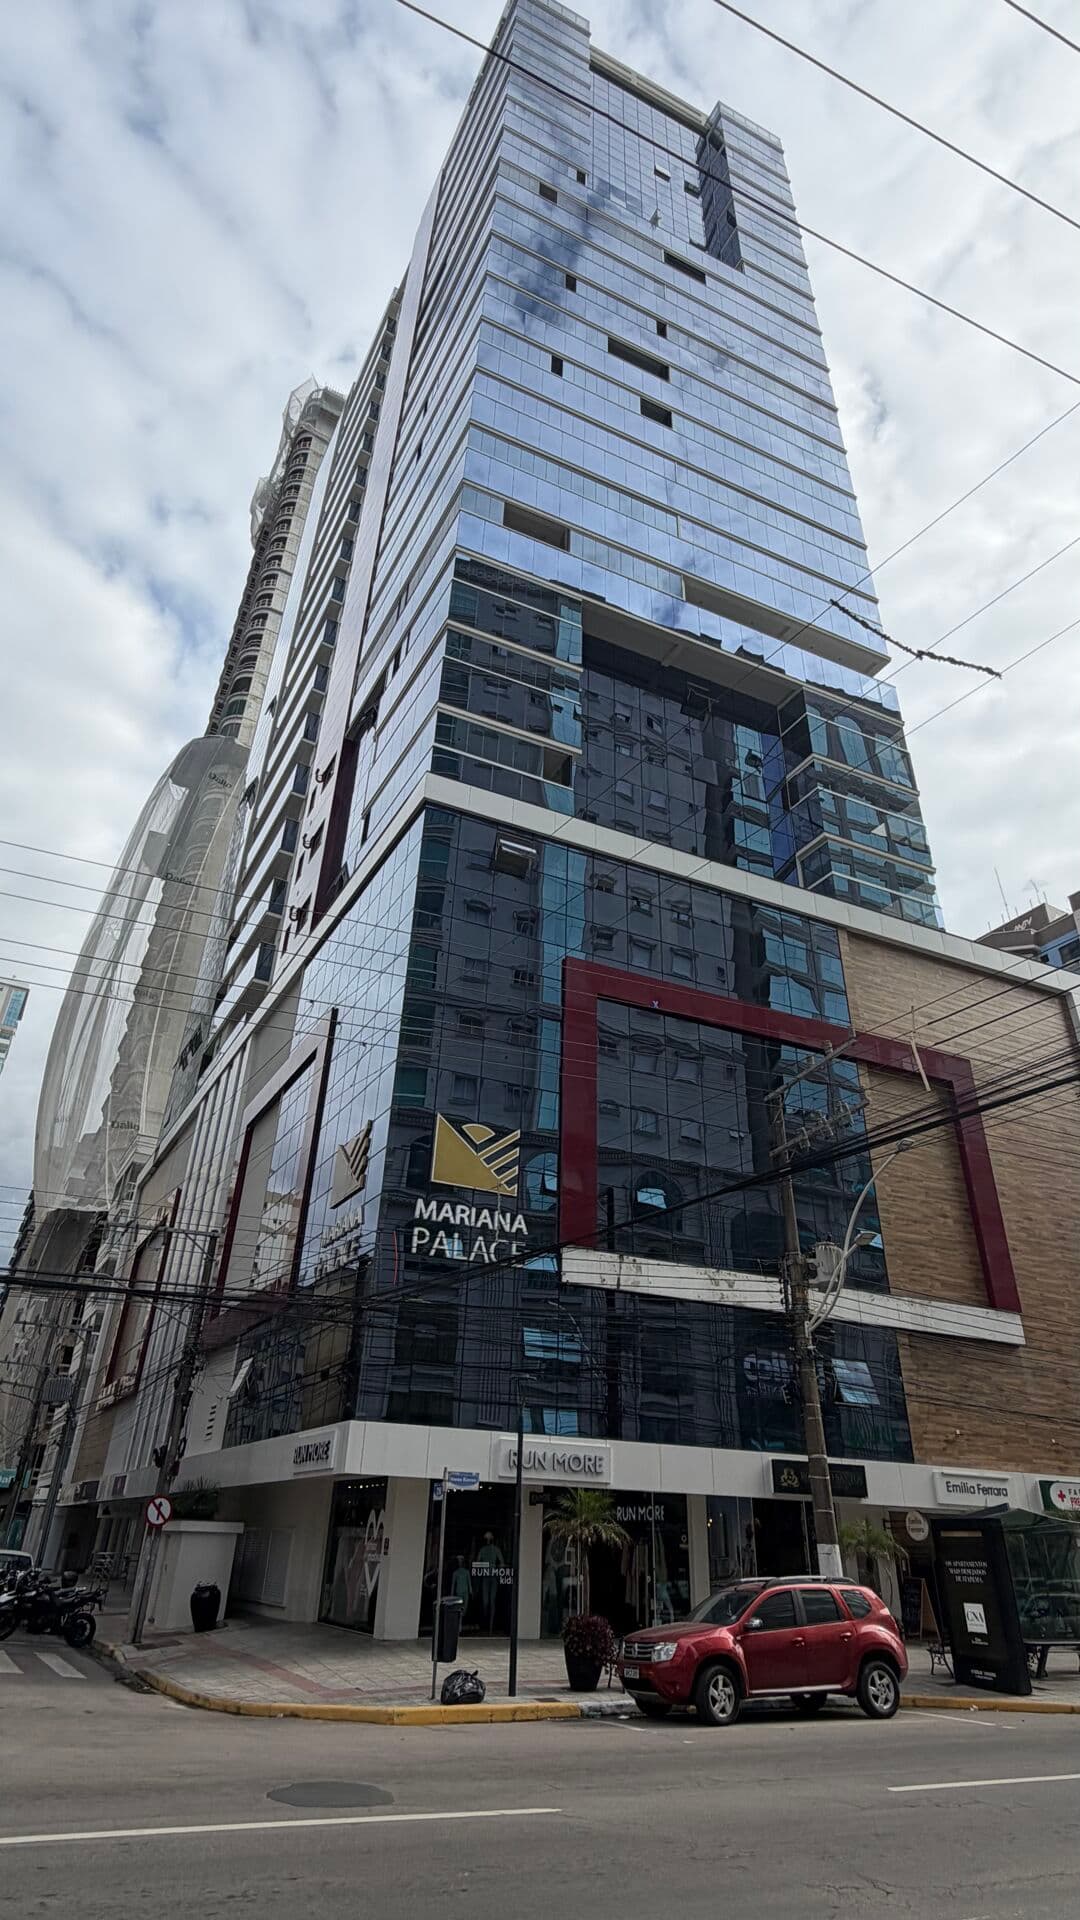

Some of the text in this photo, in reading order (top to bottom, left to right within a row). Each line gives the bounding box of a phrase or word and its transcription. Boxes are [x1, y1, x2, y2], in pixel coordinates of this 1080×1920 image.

[414, 1198, 528, 1235] MARIANA
[411, 1226, 526, 1268] PALACE
[508, 1449, 605, 1474] RUN MORE
[946, 1481, 1008, 1497] Emília Ferrara
[617, 1505, 665, 1520] RUN MORE
[472, 1568, 489, 1576] RUN
